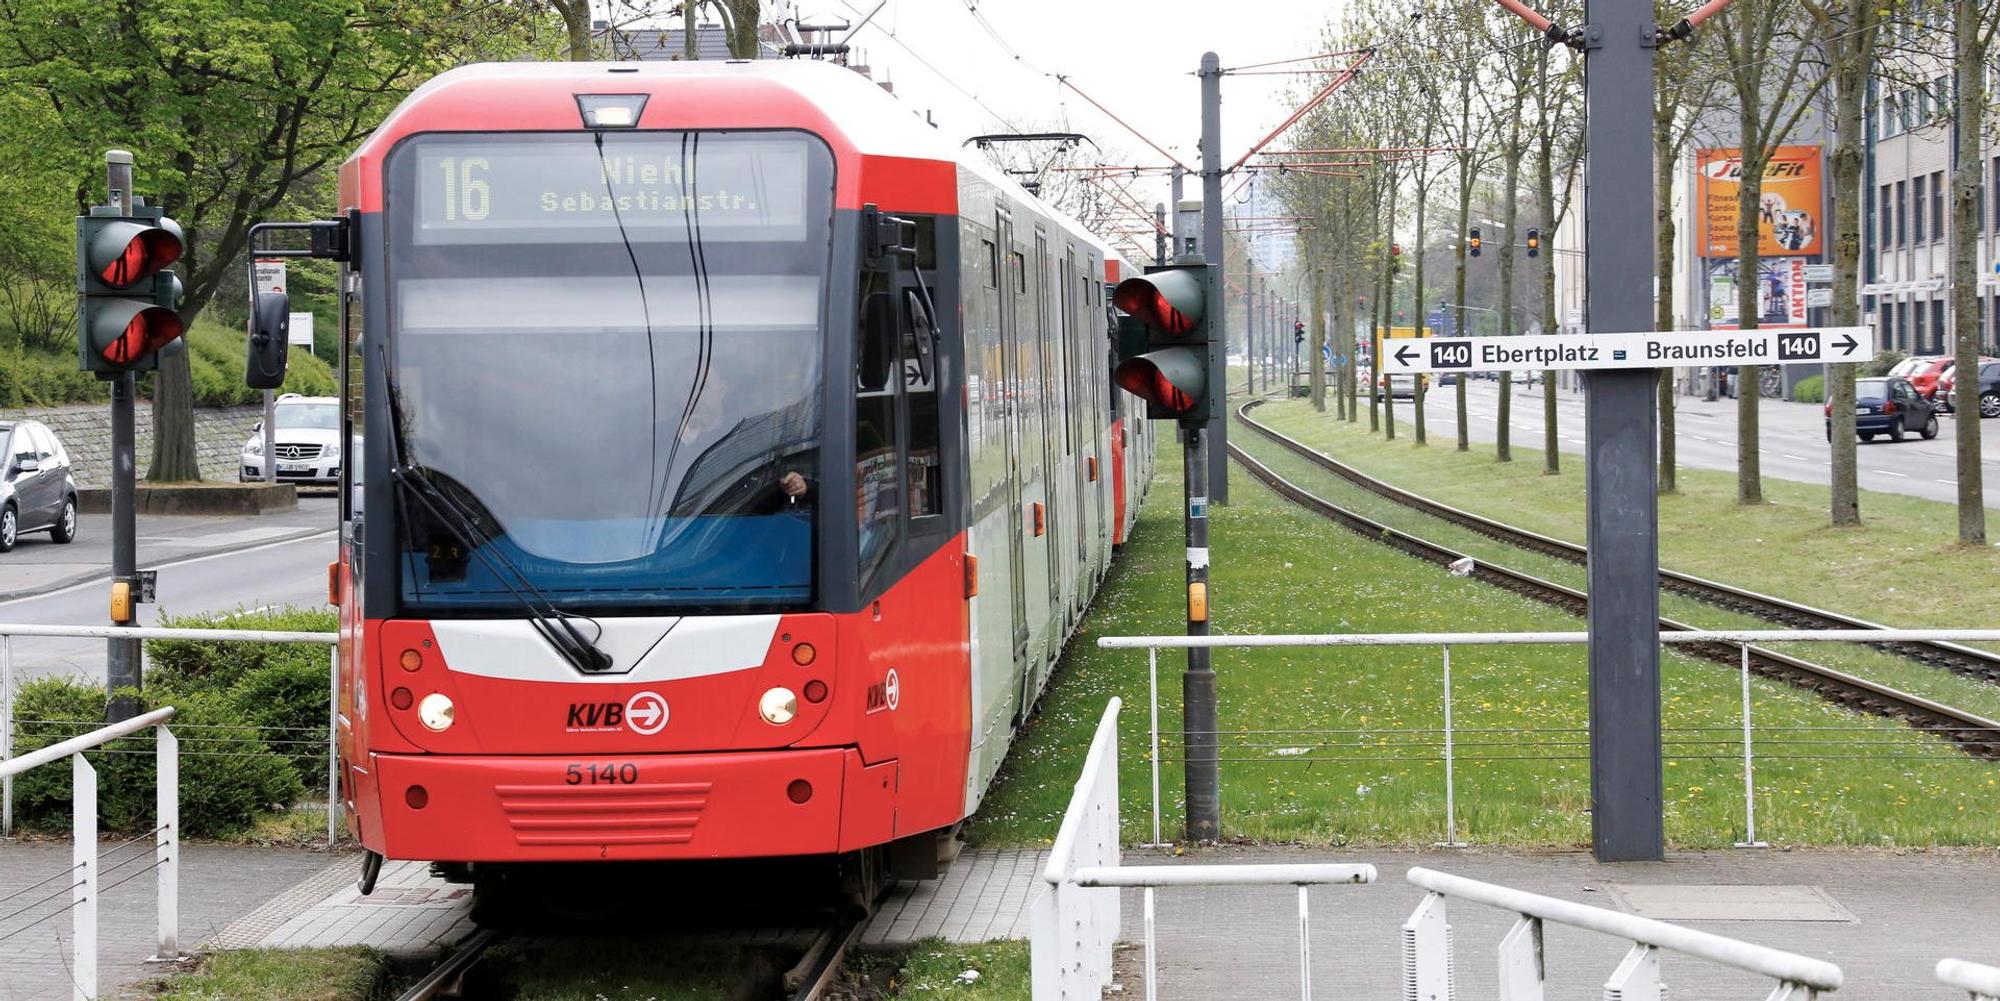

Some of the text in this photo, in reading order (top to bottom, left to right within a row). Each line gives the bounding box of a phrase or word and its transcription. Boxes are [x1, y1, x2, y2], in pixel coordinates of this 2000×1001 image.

[602, 156, 695, 184] Niehl
[440, 157, 489, 220] 16
[541, 190, 757, 213] Sebastianstr.
[1791, 259, 1805, 319] AKTION
[1434, 344, 1599, 366] 140 Ebertplatz
[1647, 337, 1817, 360] Braunsfeld 140
[567, 702, 624, 727] KVB
[565, 762, 638, 785] 5140
